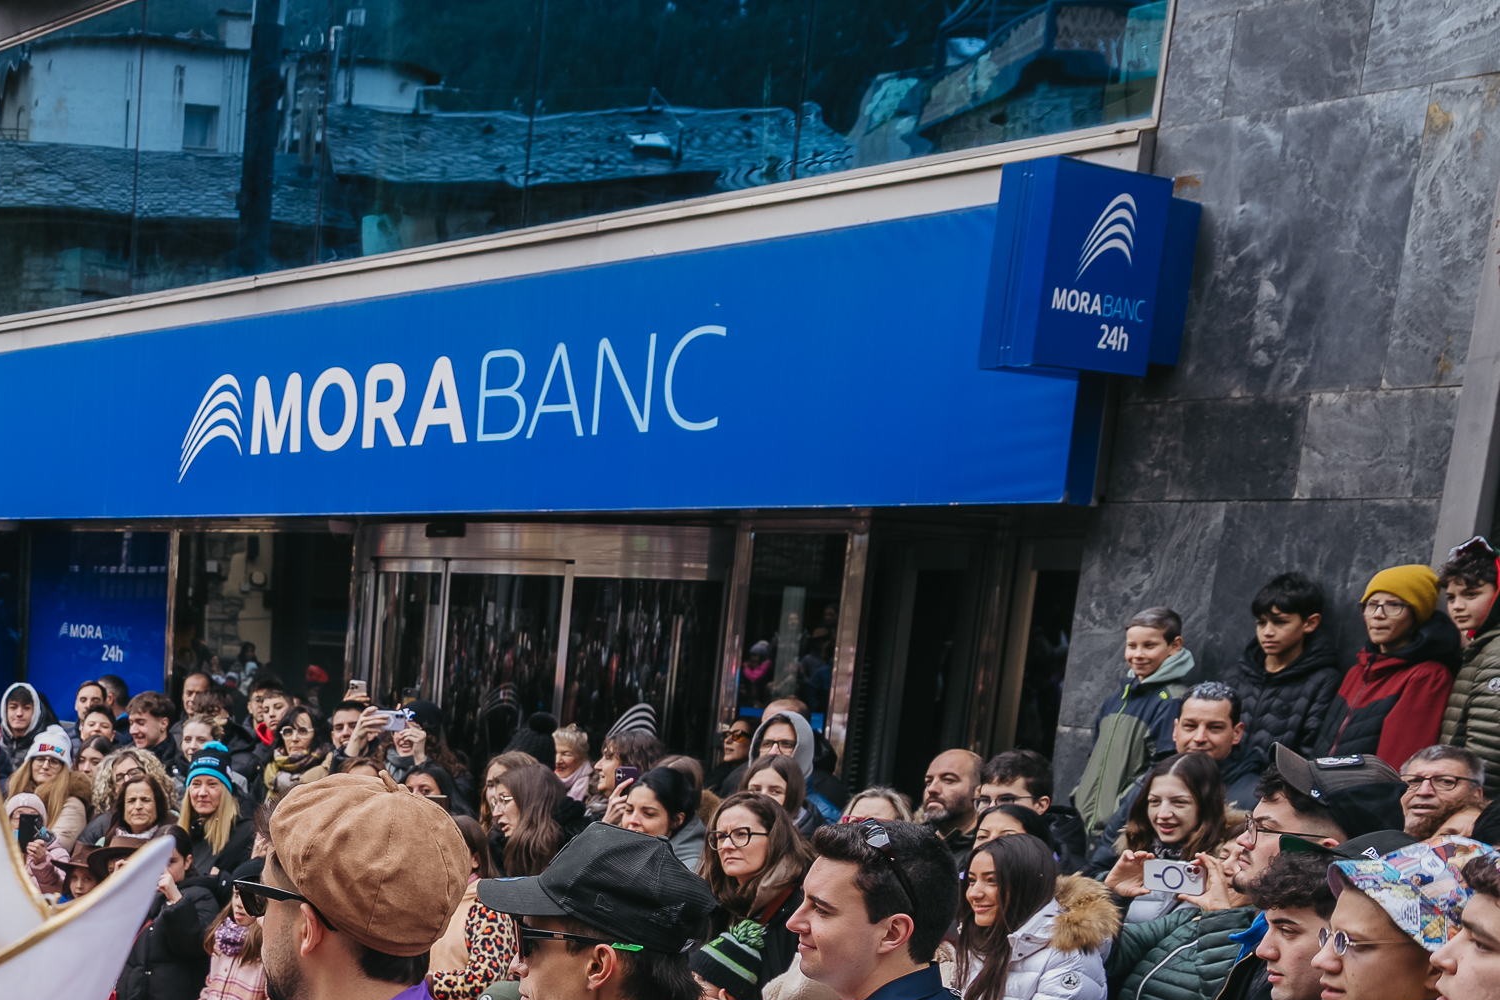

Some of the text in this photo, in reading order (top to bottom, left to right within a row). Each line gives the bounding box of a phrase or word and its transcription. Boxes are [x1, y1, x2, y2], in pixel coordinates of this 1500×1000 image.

[1052, 287, 1146, 322] MORABANC
[1097, 323, 1129, 352] 24h
[250, 325, 727, 455] MORABANC
[69, 623, 133, 642] MORABANC
[101, 644, 124, 662] 24h
